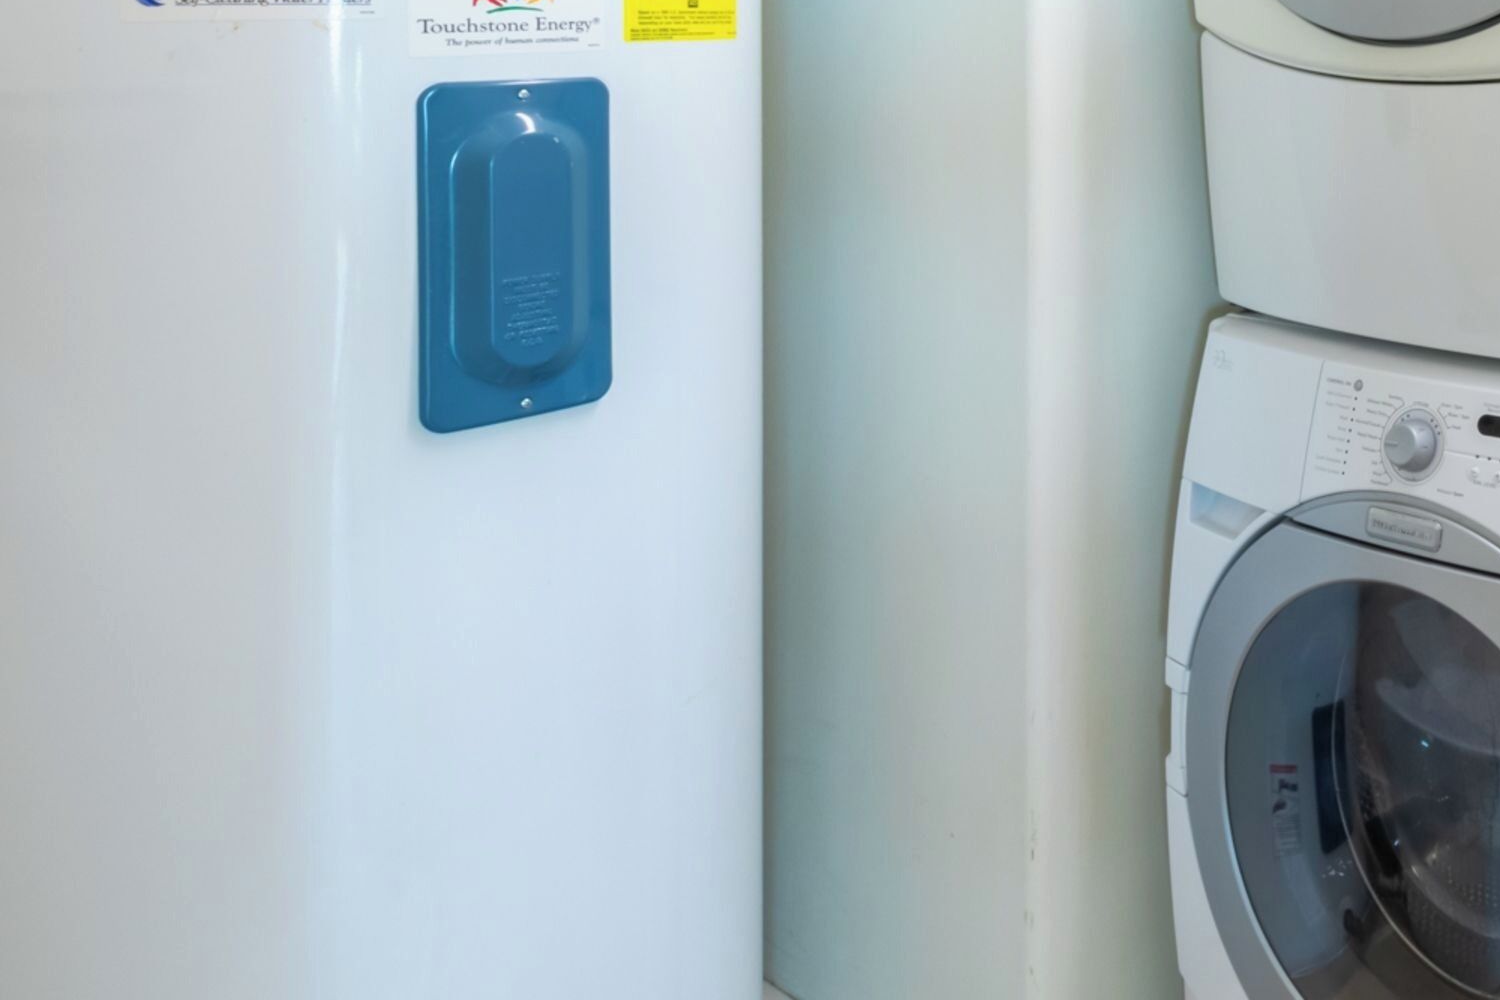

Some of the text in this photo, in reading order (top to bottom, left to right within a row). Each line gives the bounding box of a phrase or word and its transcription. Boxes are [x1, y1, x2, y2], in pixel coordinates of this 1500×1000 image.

[416, 17, 529, 35] Touchstone
[445, 37, 463, 47] The
[464, 38, 492, 48] power
[493, 36, 504, 47] of
